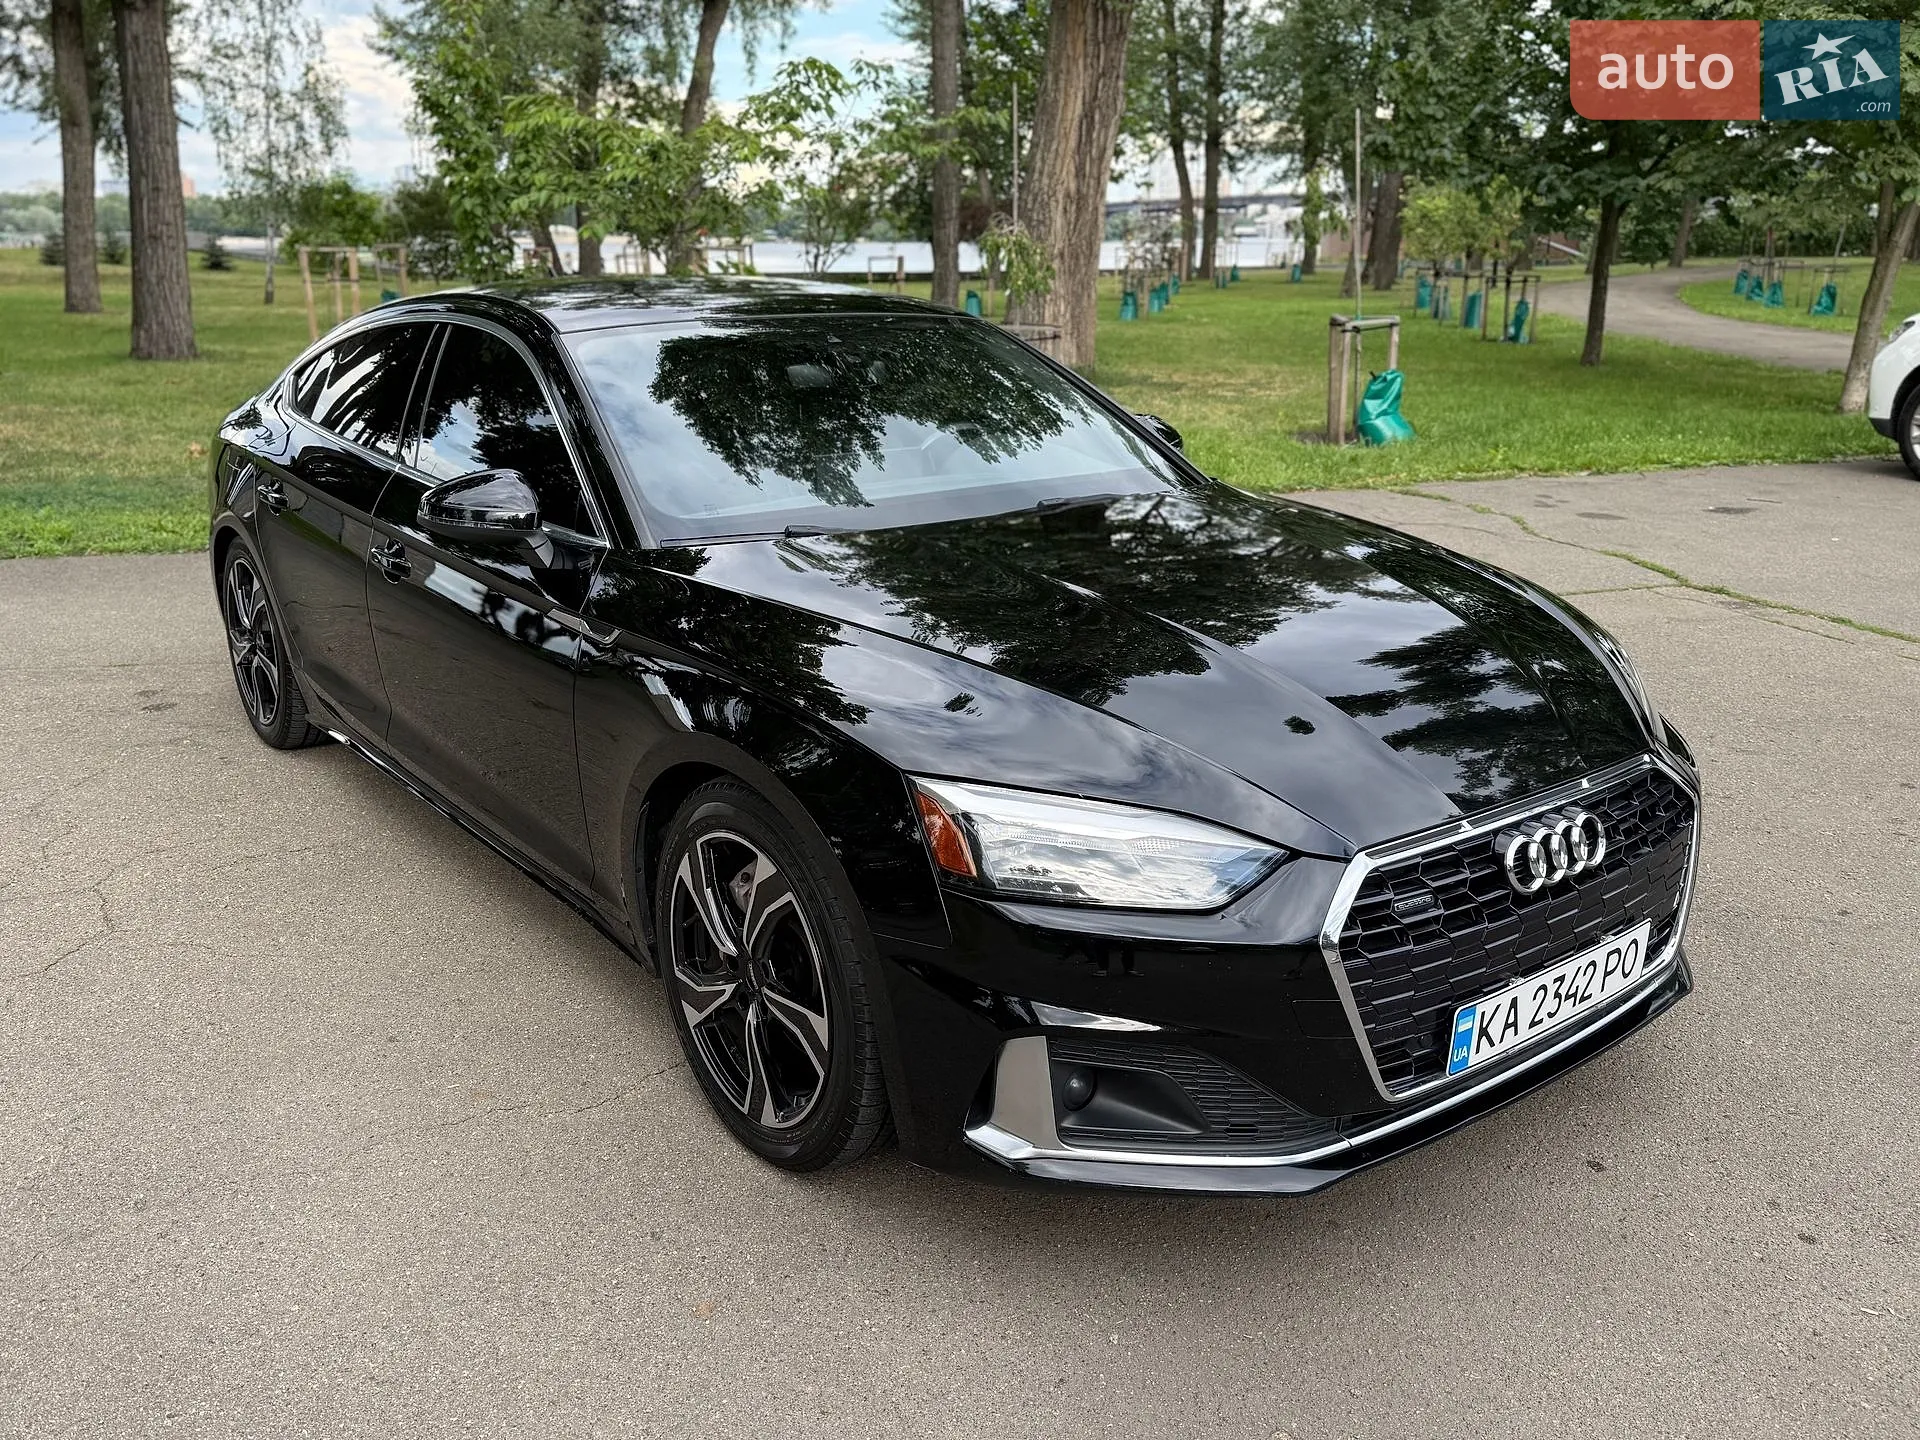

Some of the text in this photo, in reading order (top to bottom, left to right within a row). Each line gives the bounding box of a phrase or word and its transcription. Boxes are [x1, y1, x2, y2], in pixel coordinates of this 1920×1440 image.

[1475, 938, 1638, 1055] KA 2342 PO
[1452, 1046, 1469, 1063] UA
